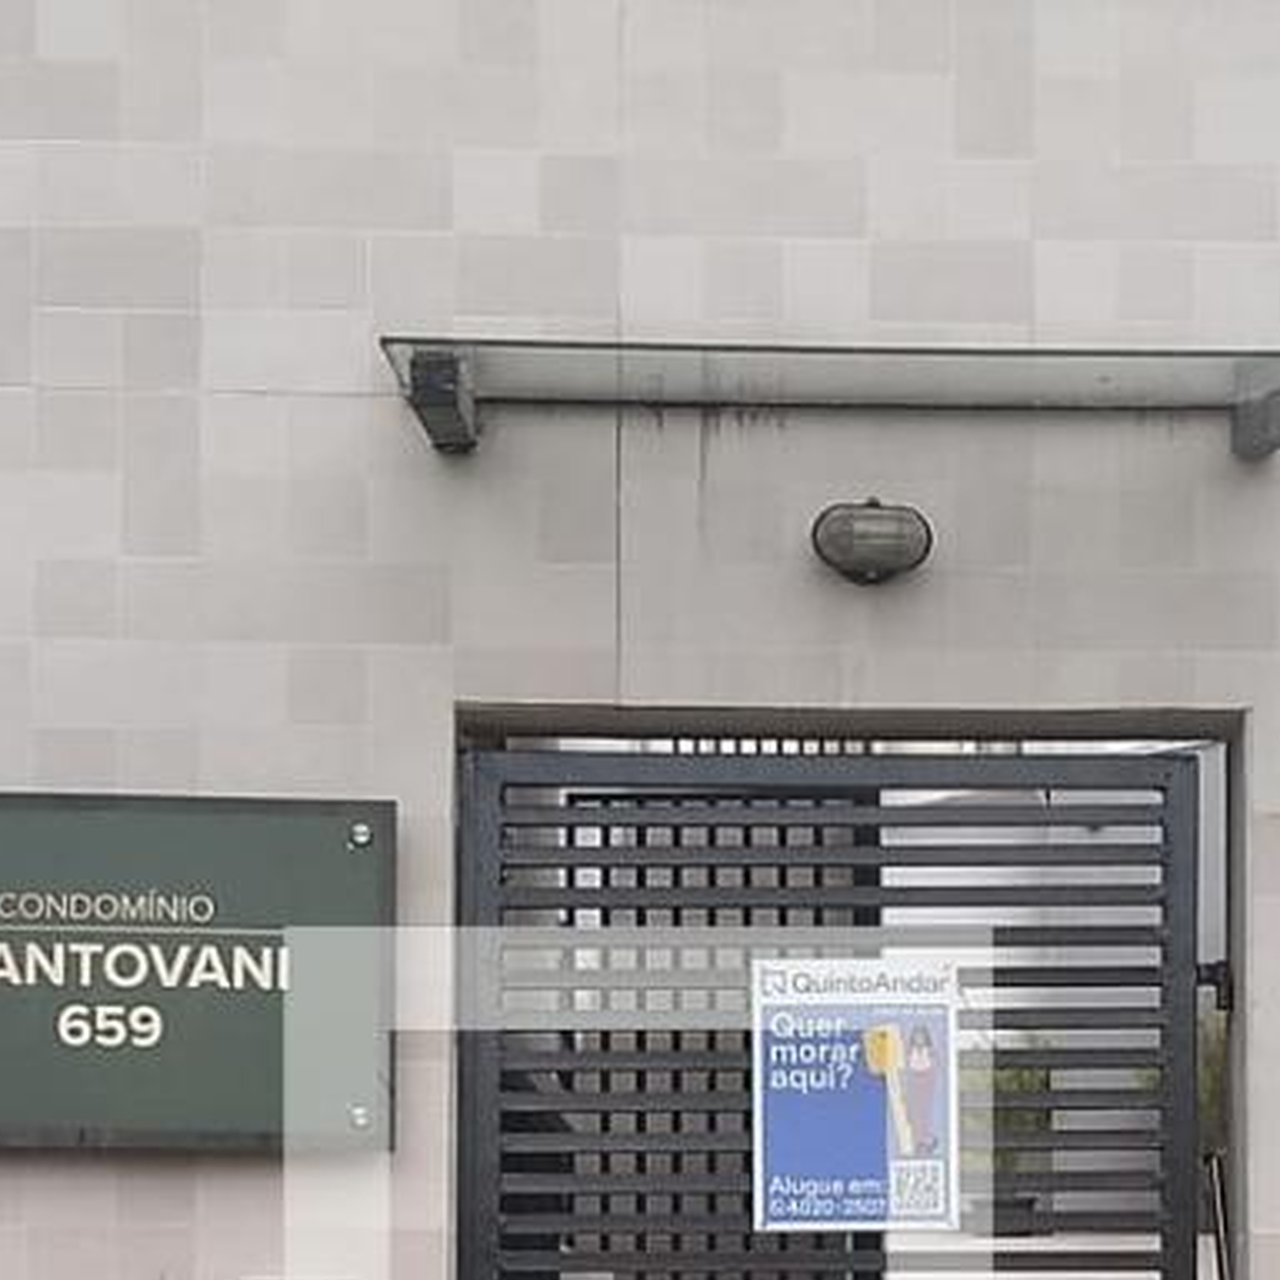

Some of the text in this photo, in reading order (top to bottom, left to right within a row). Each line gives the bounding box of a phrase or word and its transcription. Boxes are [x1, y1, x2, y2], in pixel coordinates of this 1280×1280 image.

[792, 971, 950, 994] QuintoAndar
[57, 1004, 163, 1048] 659
[772, 1011, 846, 1039] Quer
[771, 1042, 859, 1065] morar
[771, 1062, 854, 1095] aqui?
